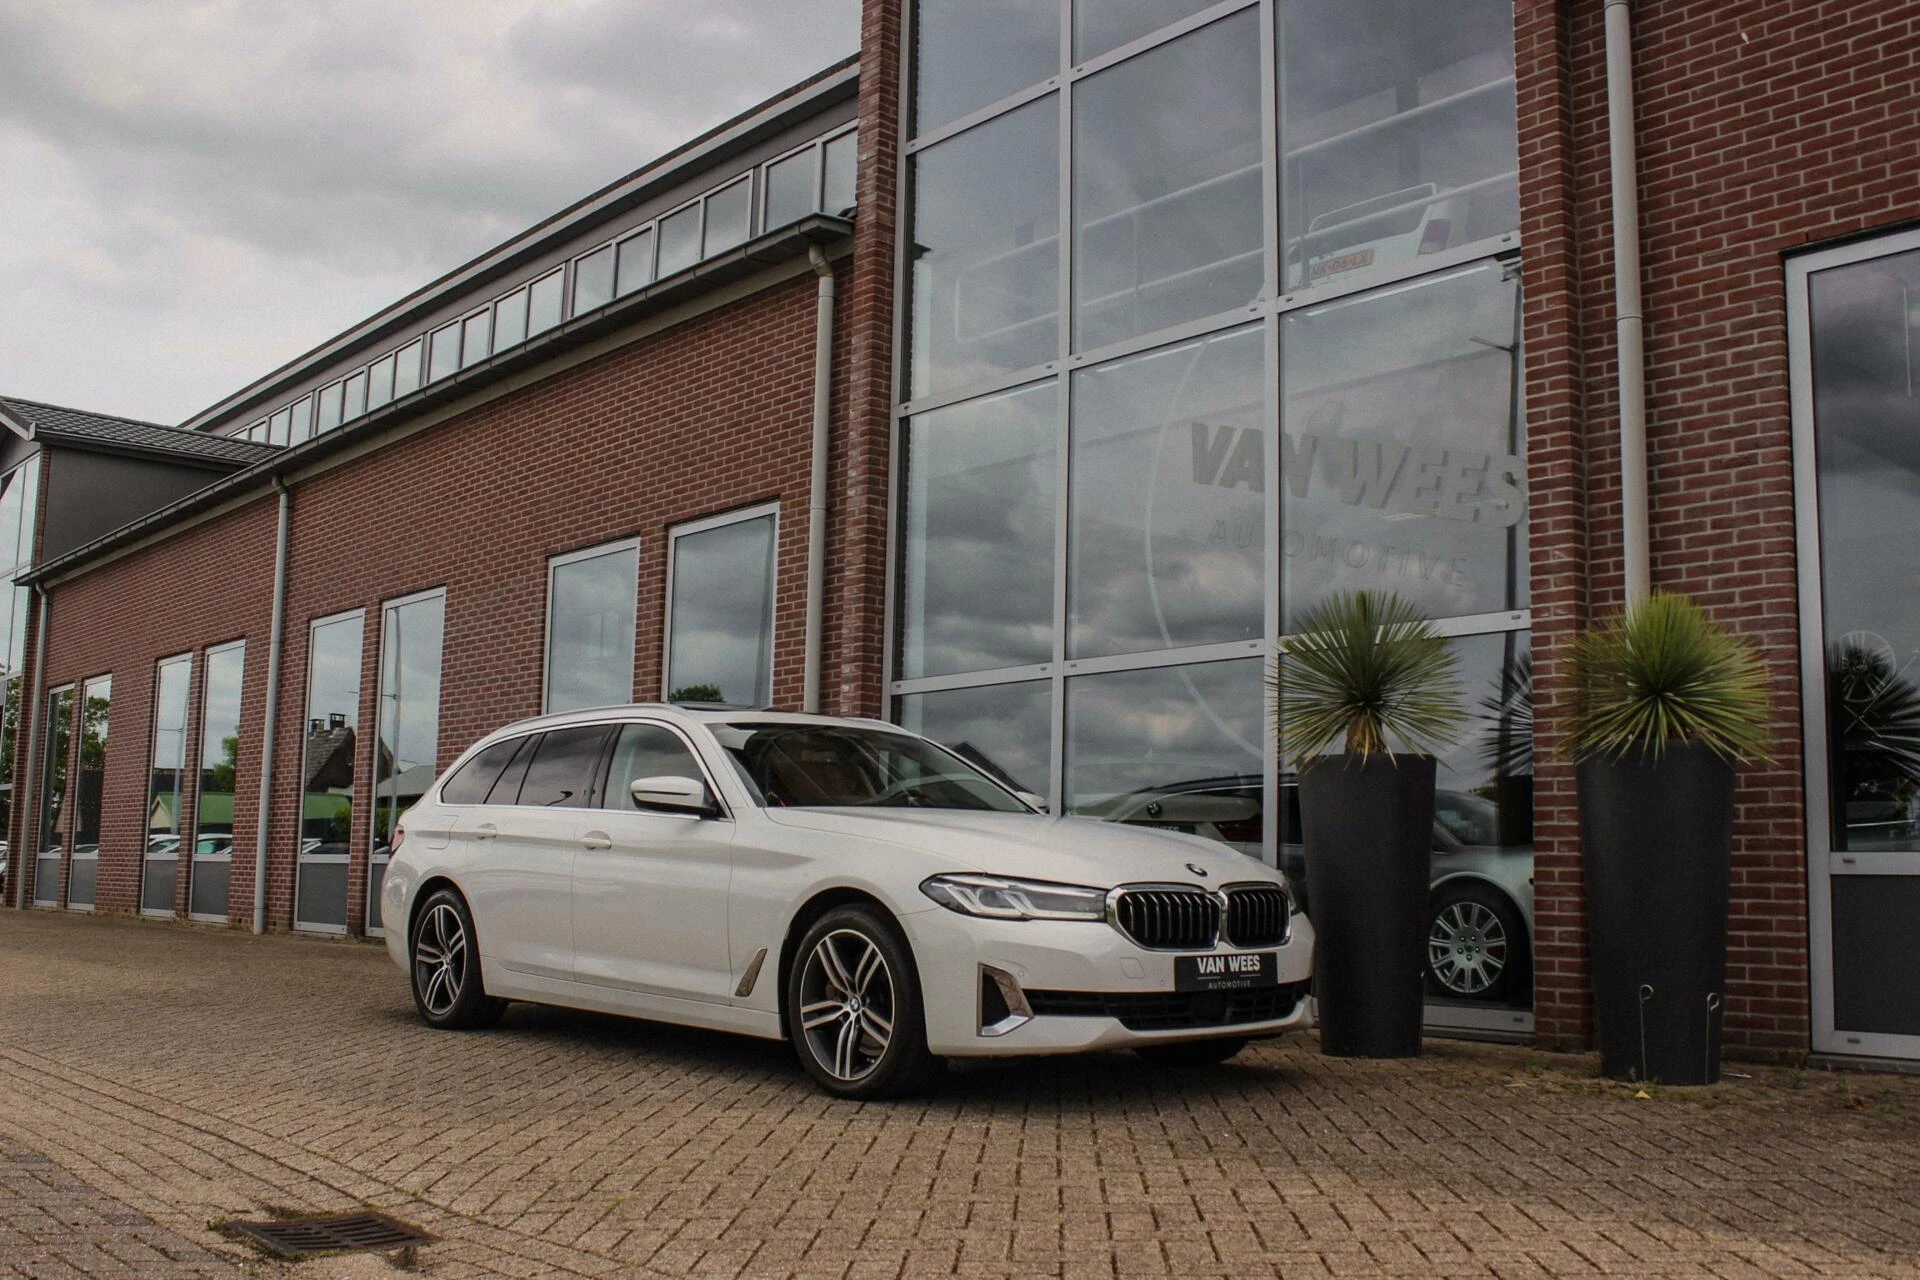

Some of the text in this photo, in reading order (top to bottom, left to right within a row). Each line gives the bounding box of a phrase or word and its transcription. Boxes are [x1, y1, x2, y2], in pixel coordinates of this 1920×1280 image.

[1191, 422, 1526, 528] VAN WEES
[1207, 519, 1468, 588] AUOMOTIVE
[1197, 954, 1261, 974] VAN WEES
[1208, 980, 1251, 990] AUTOMOTIVE
